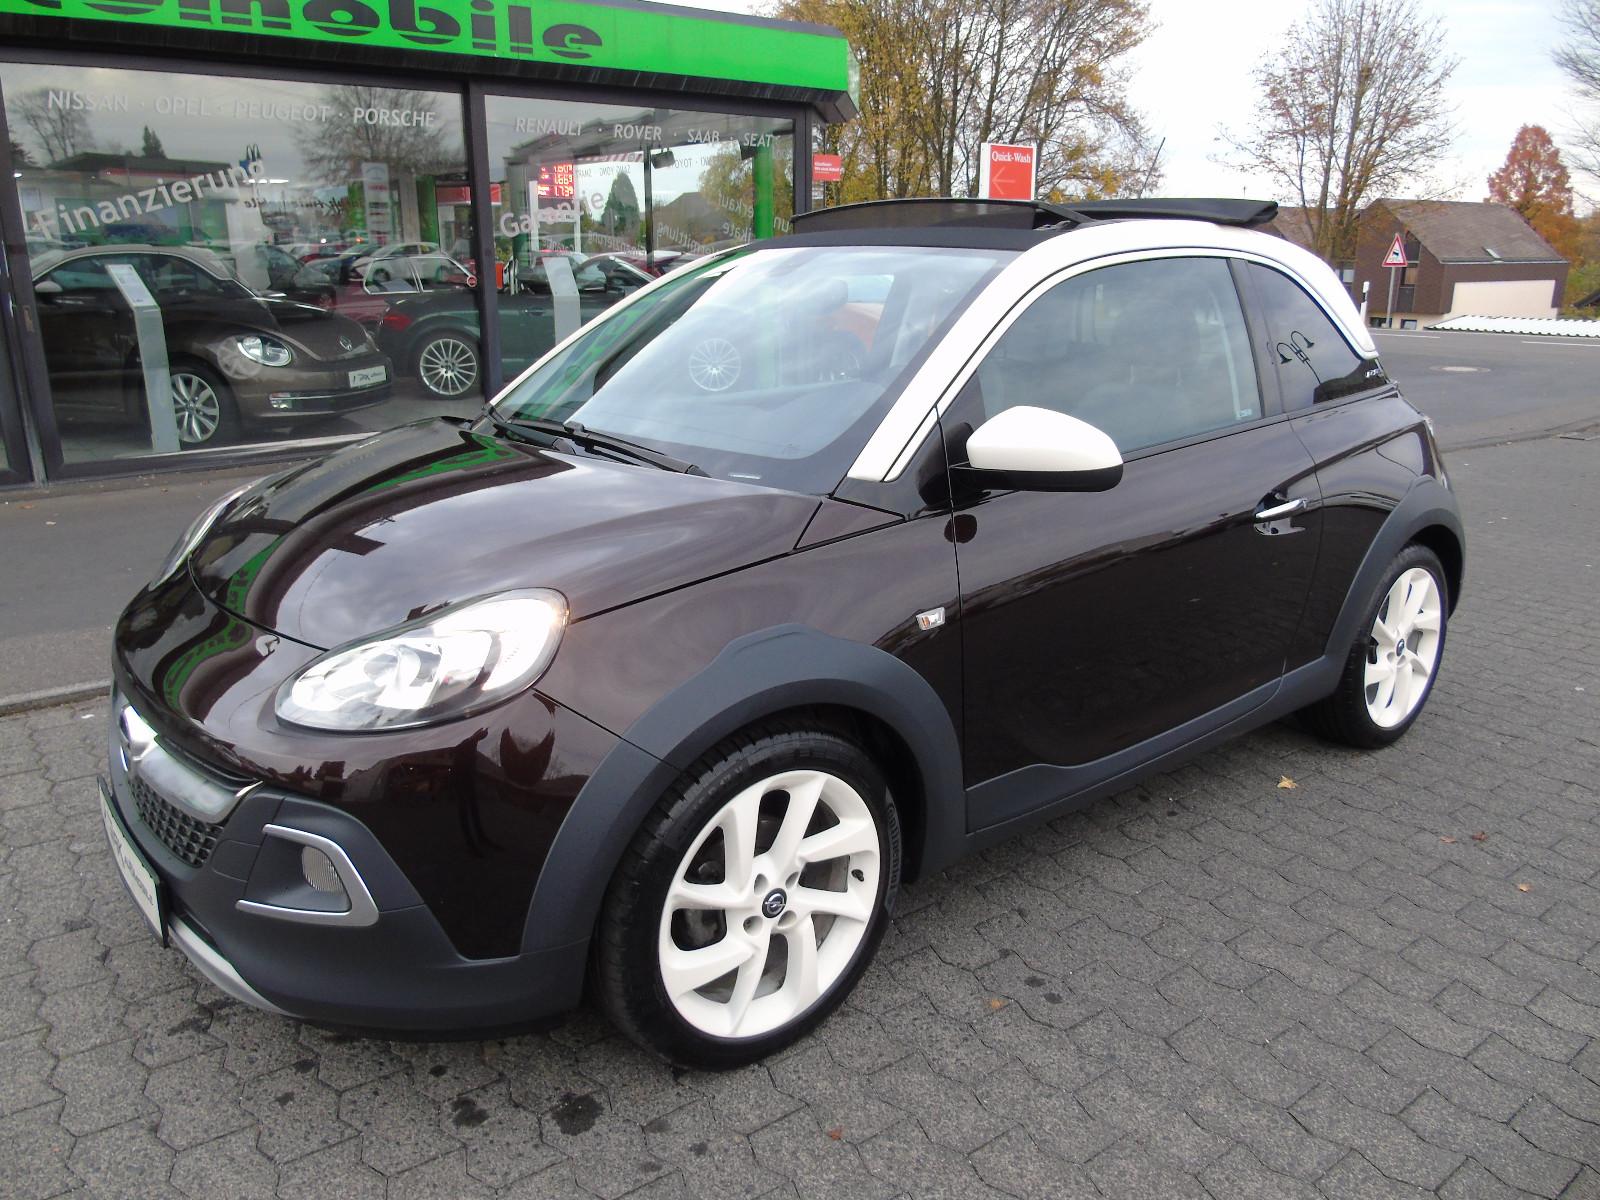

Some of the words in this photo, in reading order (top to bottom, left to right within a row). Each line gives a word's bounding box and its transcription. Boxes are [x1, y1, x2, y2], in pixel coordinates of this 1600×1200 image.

[48, 90, 128, 112] NISSAN
[155, 95, 211, 116] OPEL
[234, 99, 330, 123] PEUGEOT
[353, 107, 436, 128] PORSCHE
[515, 117, 582, 136] RENAULT
[613, 124, 662, 141] ROVER
[687, 129, 720, 144] SAAB
[743, 133, 774, 147] SEAT
[991, 150, 1031, 163] Quick-Wash
[34, 159, 266, 241] Finanzierung
